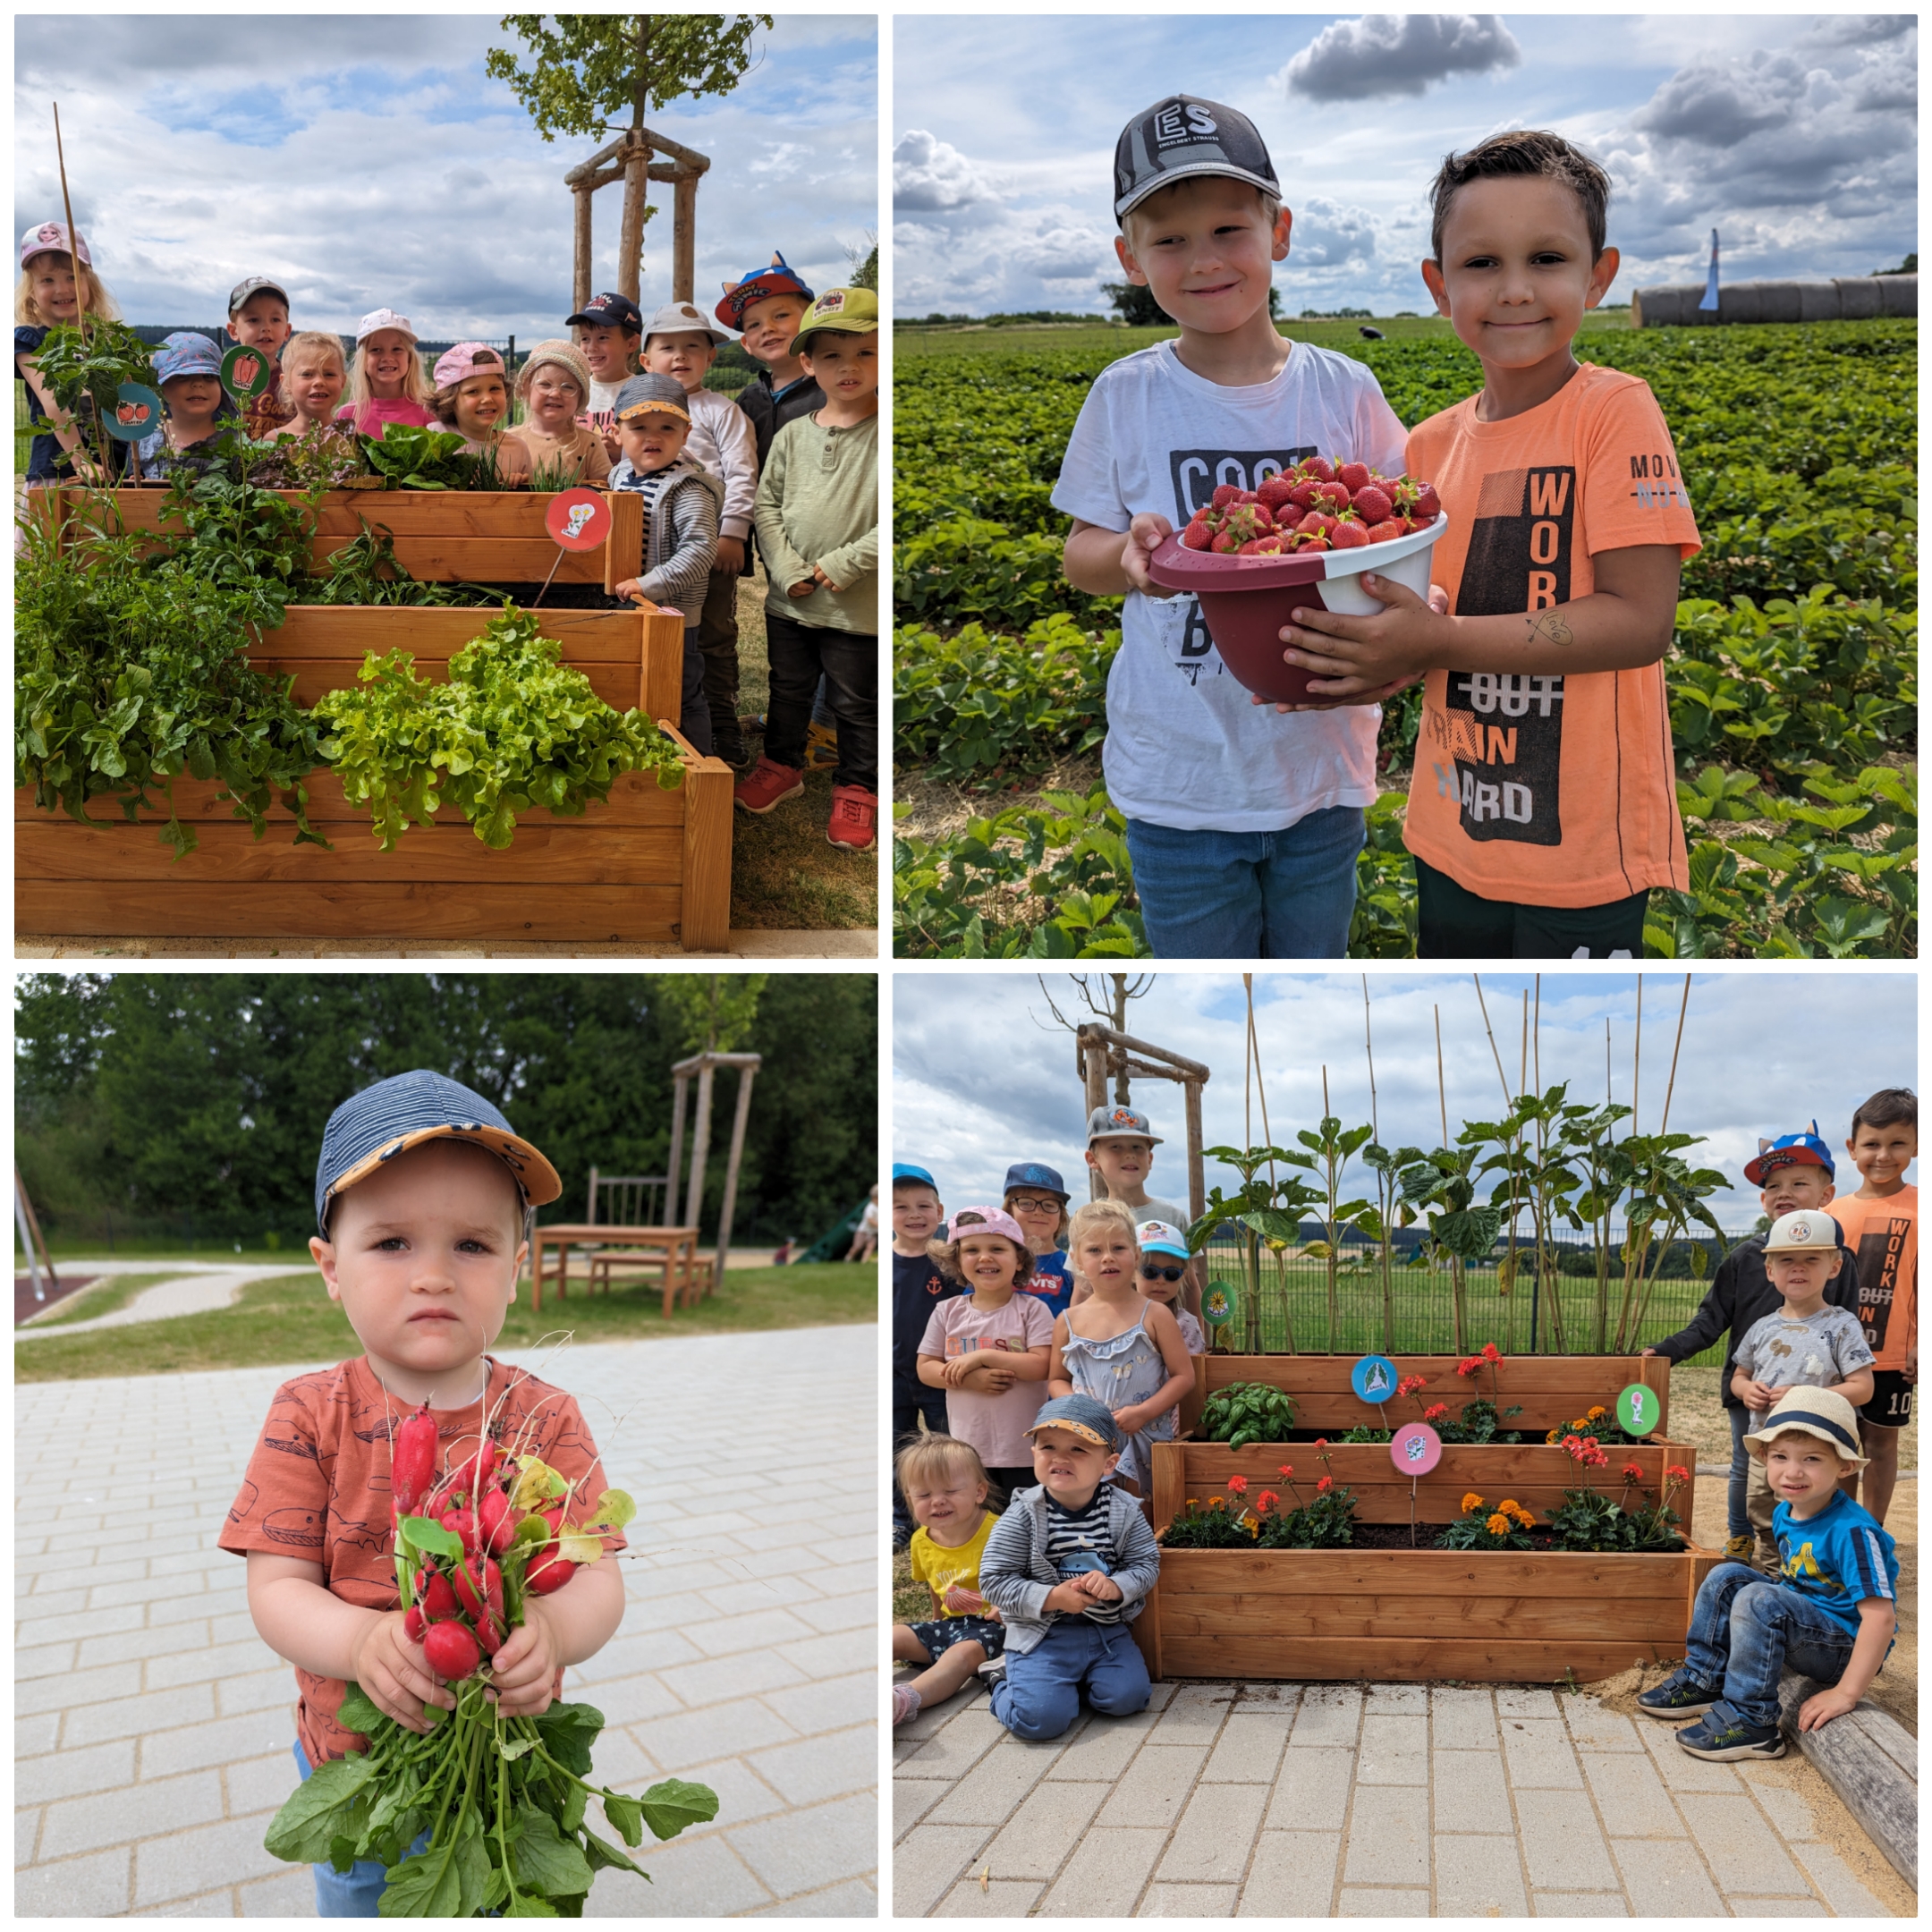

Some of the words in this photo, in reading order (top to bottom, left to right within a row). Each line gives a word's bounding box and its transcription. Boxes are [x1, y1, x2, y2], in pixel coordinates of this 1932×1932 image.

[1155, 103, 1217, 142] ES
[727, 283, 758, 303] TEAM
[732, 288, 771, 313] SONIC
[1630, 454, 1677, 479] MOV
[1527, 472, 1571, 613] WOR
[1470, 673, 1563, 717] OUT
[1433, 762, 1533, 824] HARD
[1879, 1219, 1909, 1288] WORK
[1859, 1287, 1893, 1305] OUT
[946, 1337, 1023, 1355] GUESS
[1887, 1392, 1911, 1414] 10
